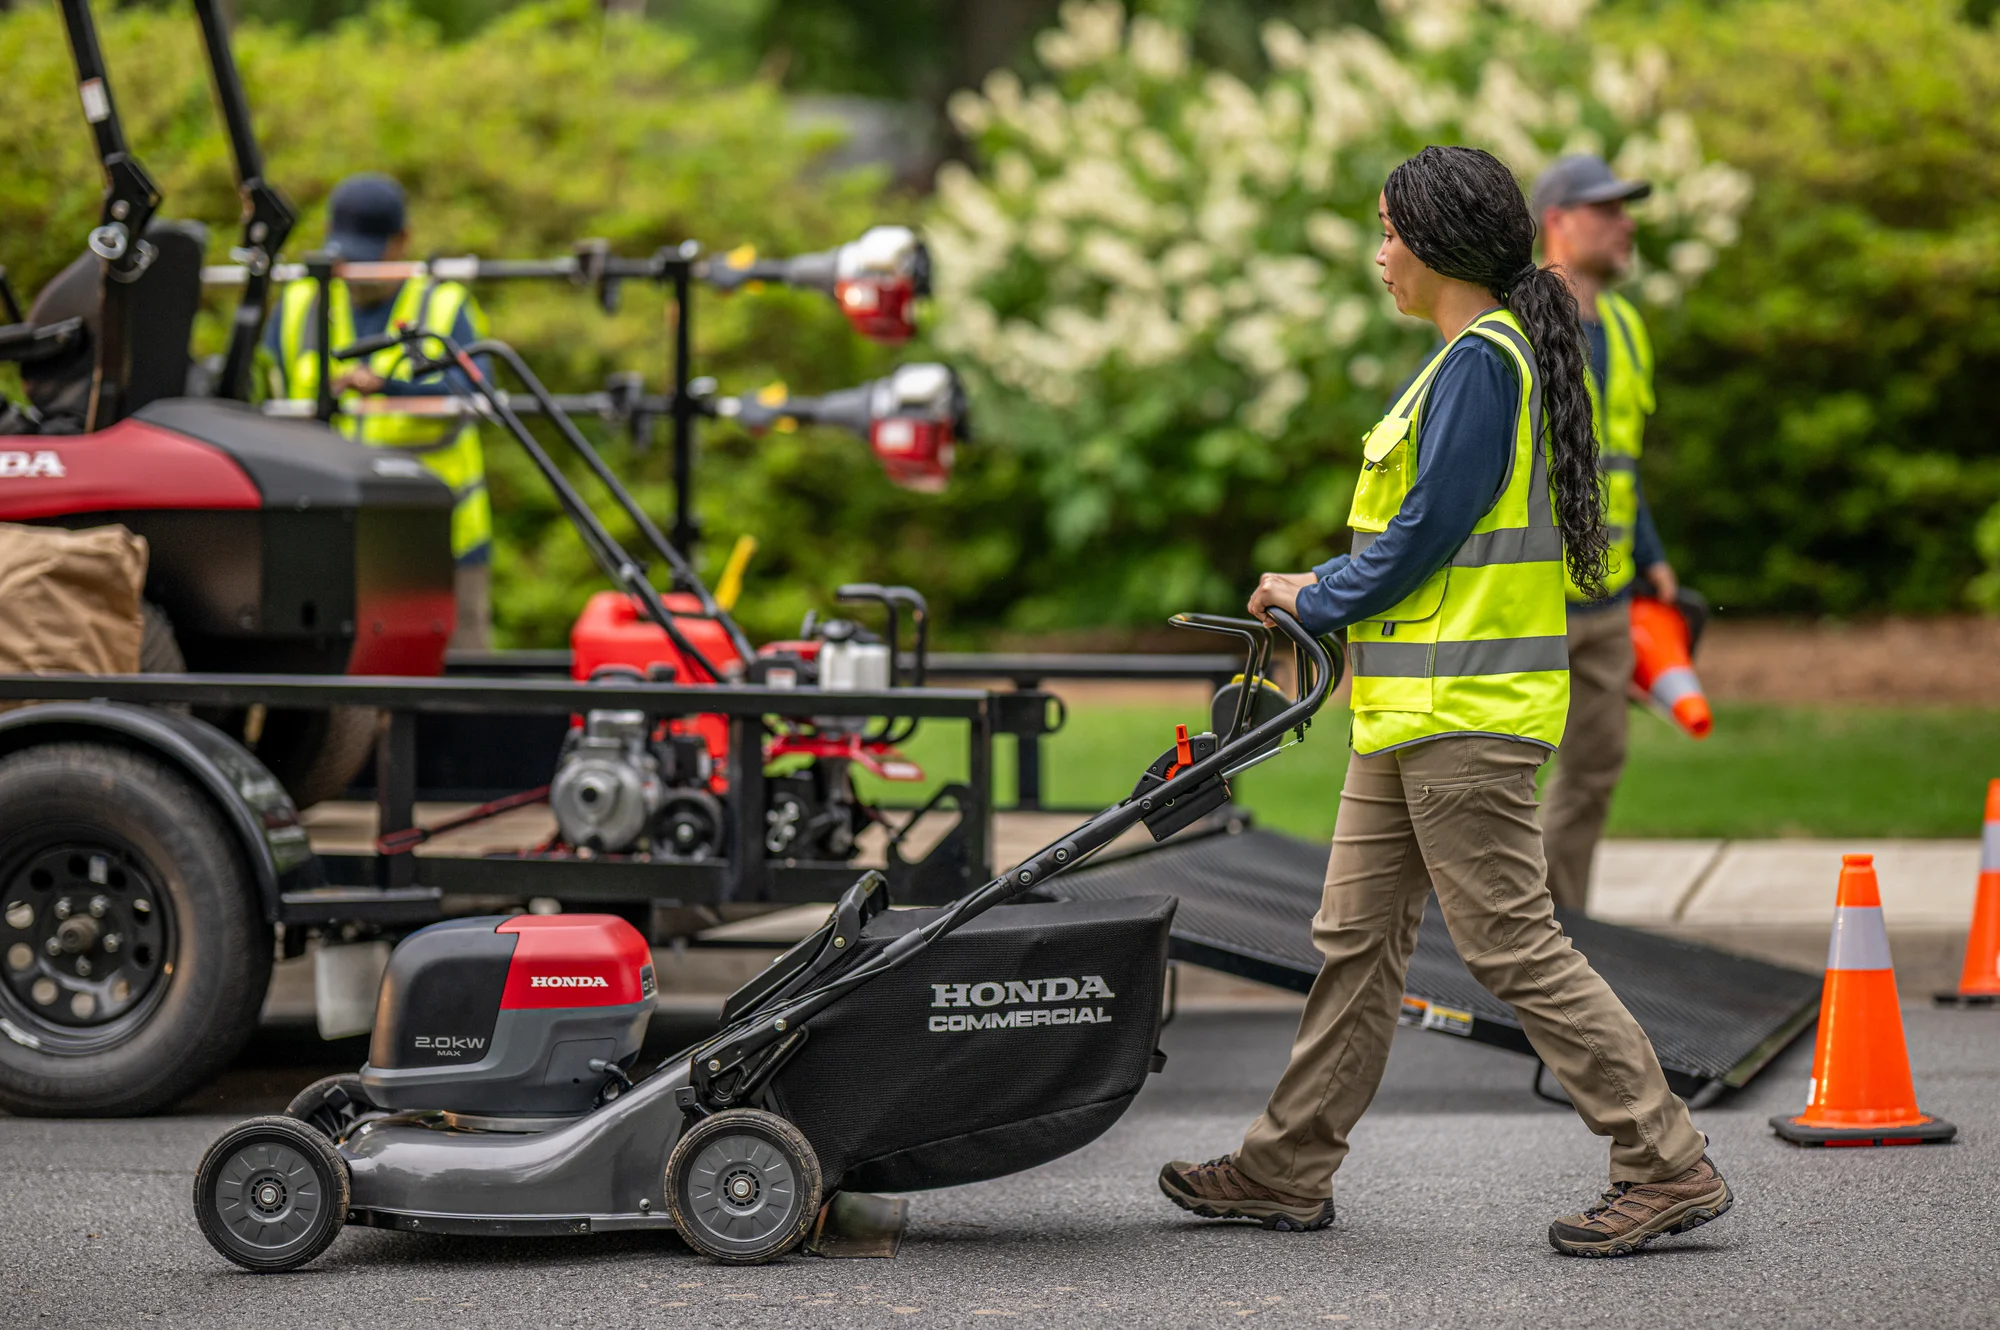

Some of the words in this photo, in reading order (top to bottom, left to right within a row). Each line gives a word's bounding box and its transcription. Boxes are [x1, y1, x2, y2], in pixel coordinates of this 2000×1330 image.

[530, 976, 609, 988] HONDA
[930, 975, 1116, 1008] HONDA
[928, 1006, 1112, 1032] COMMERCIAL
[414, 1036, 486, 1049] 2.0kW
